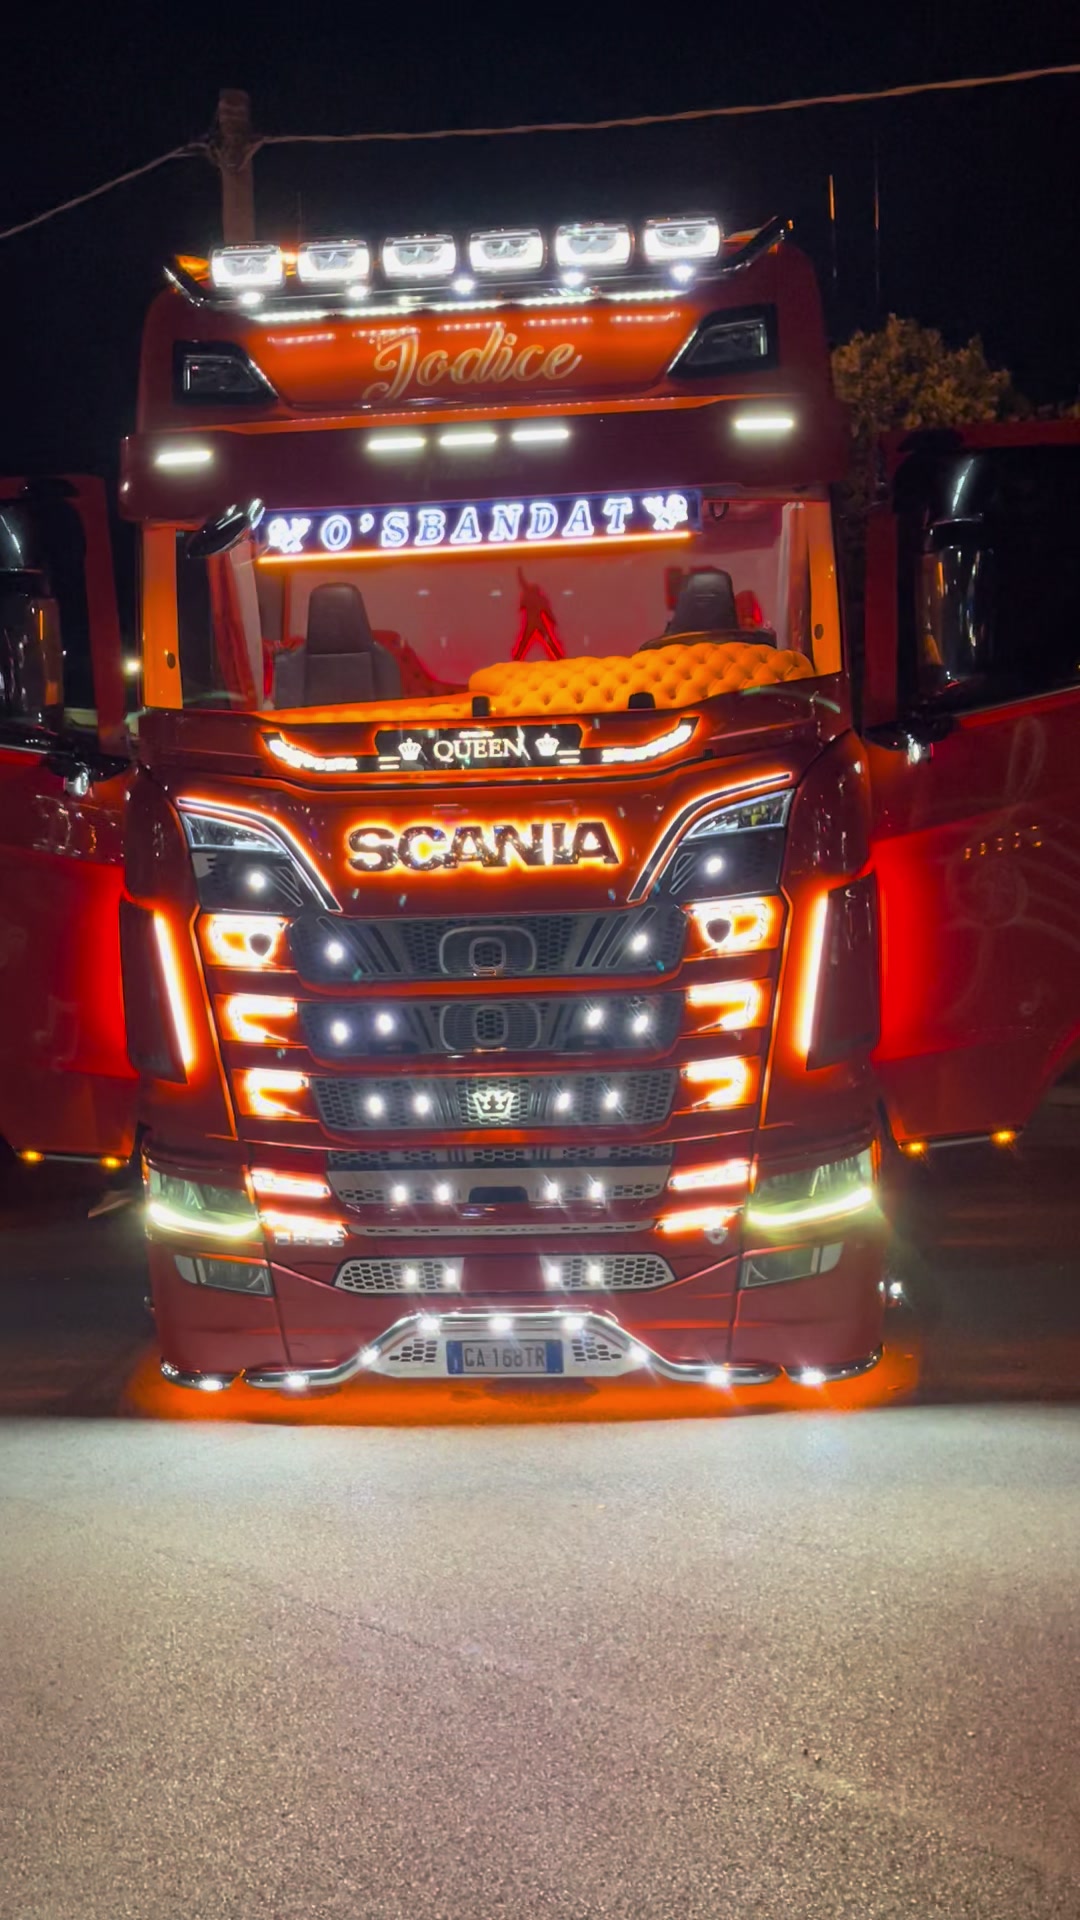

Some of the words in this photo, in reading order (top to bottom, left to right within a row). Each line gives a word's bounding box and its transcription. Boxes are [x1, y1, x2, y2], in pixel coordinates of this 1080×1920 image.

[362, 325, 583, 400] Jodice
[433, 738, 523, 762] QUEEN
[348, 821, 620, 872] SCANIA
